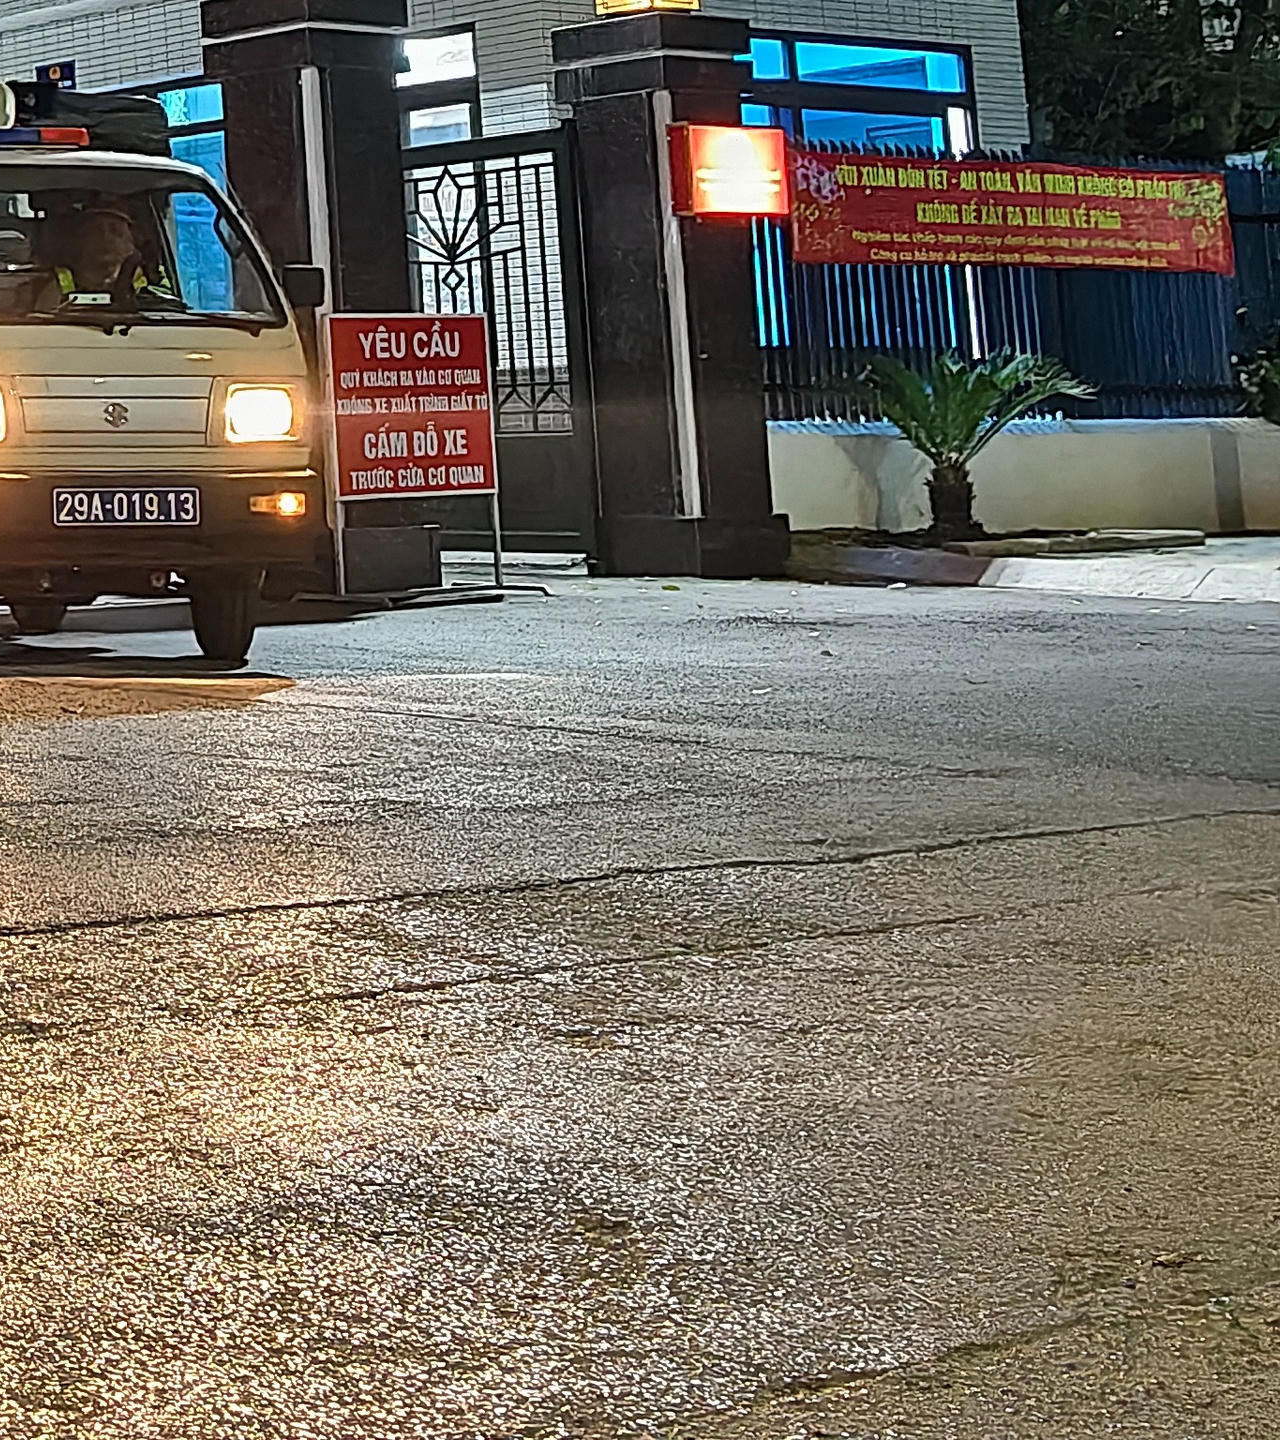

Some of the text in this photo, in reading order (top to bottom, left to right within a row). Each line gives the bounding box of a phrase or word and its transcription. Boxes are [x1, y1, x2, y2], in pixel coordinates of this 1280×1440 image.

[927, 164, 948, 191] TẾT
[916, 199, 958, 224] KHÔNG
[358, 321, 460, 359] YÊU CẦU
[340, 368, 360, 390] QUÝ
[363, 368, 398, 388] KHÁCH
[399, 370, 414, 386] RA
[415, 366, 436, 386] VÀO
[437, 369, 452, 385] CƠ
[374, 397, 389, 414] XE
[364, 421, 468, 460] CẤM ĐỖ XE
[350, 462, 485, 490] TRƯỚC CỬA CƠ QUAN
[58, 492, 194, 521] 29A-019.13
